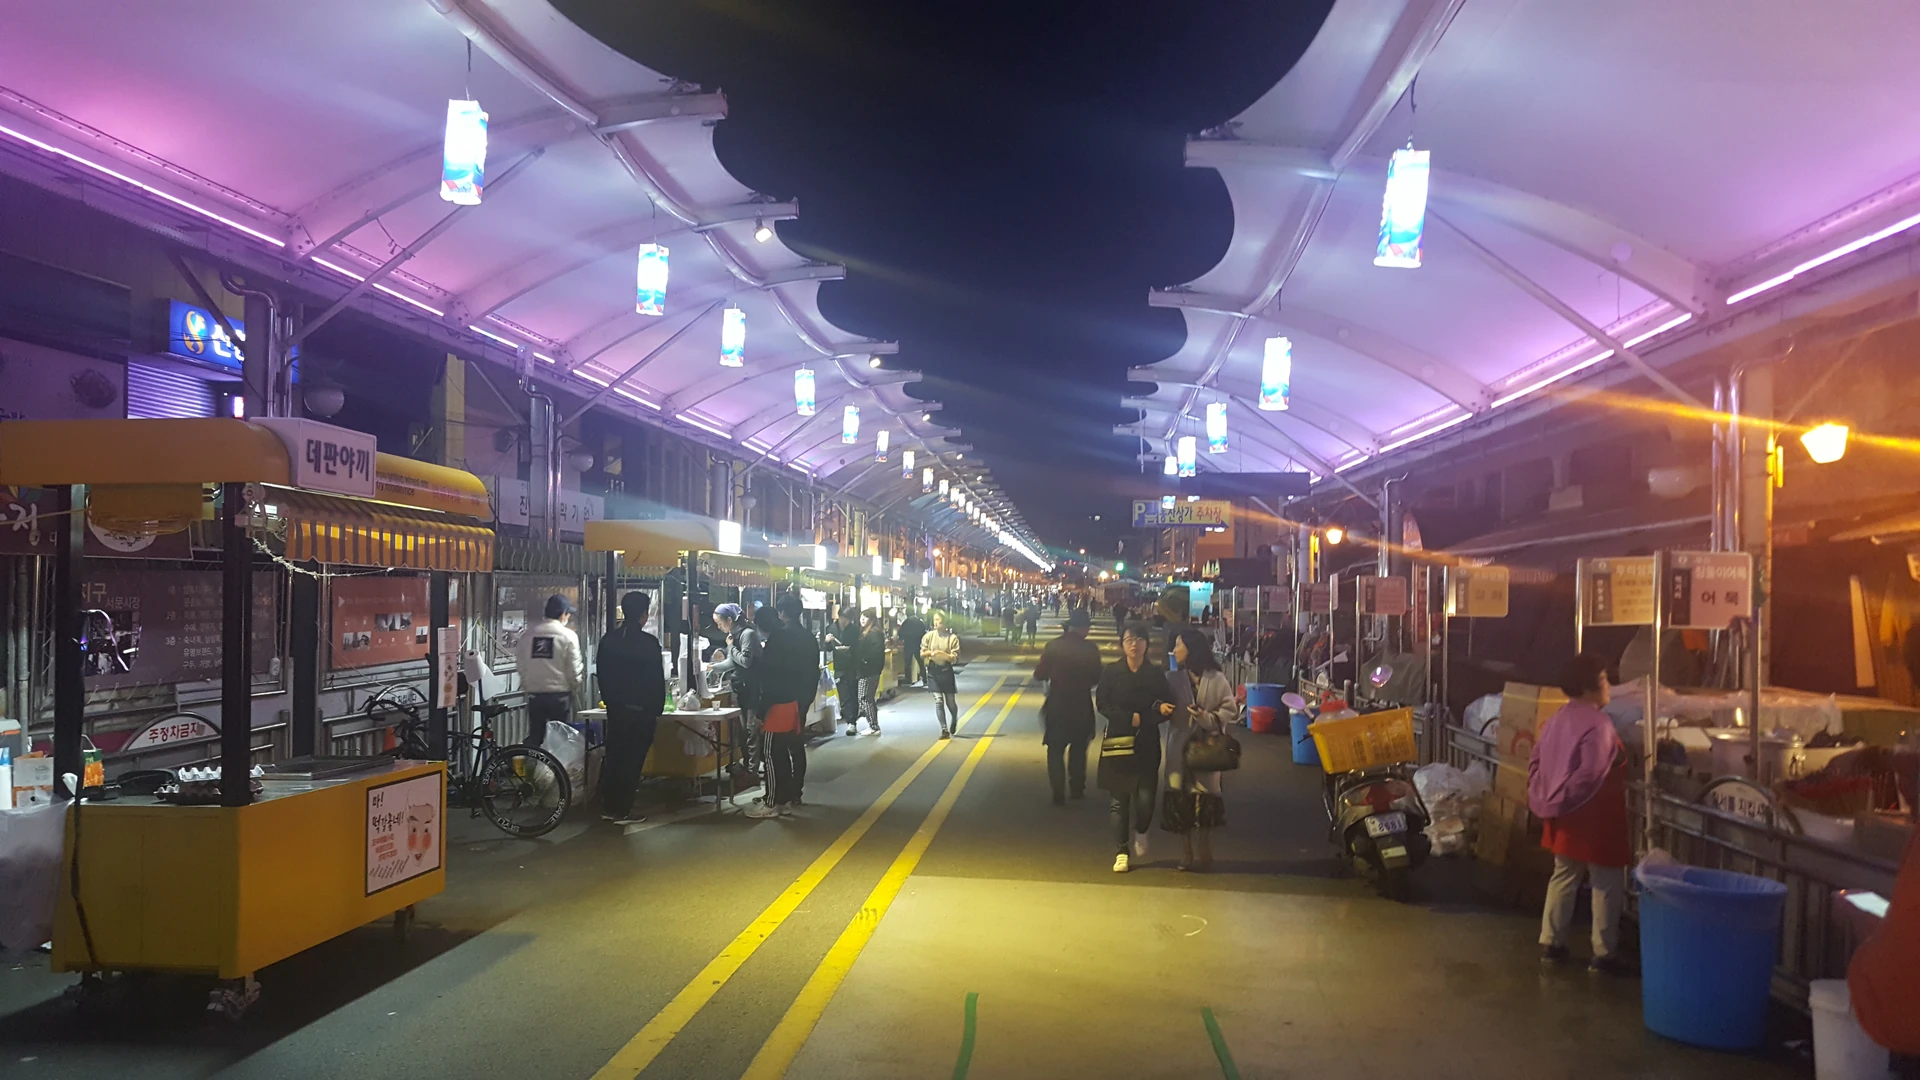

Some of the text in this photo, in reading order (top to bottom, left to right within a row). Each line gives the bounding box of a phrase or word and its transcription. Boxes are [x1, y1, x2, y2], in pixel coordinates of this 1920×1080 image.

[306, 438, 370, 482] 데판야끼
[1134, 503, 1146, 521] P
[1196, 506, 1222, 524] 주차장
[105, 596, 140, 609] 서문시장
[149, 722, 199, 744] 주정차금지
